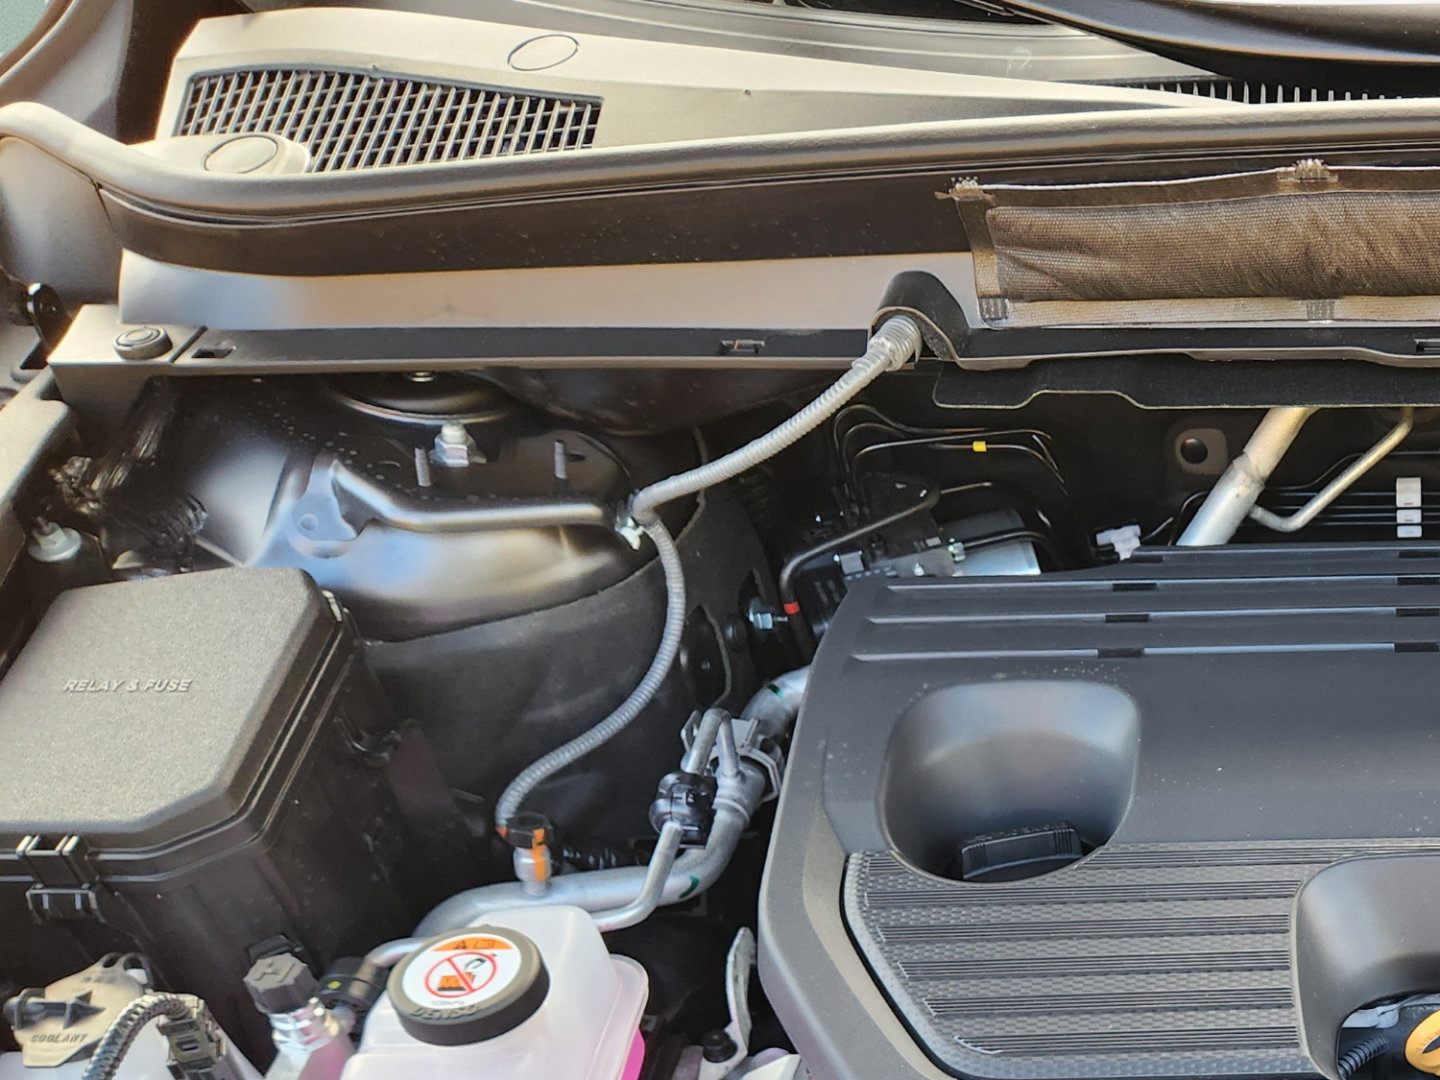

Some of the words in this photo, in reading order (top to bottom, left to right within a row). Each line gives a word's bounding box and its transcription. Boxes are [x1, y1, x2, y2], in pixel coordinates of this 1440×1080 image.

[62, 679, 124, 692] RELAY
[143, 679, 193, 692] FUSE
[31, 1033, 88, 1044] COOLANT
